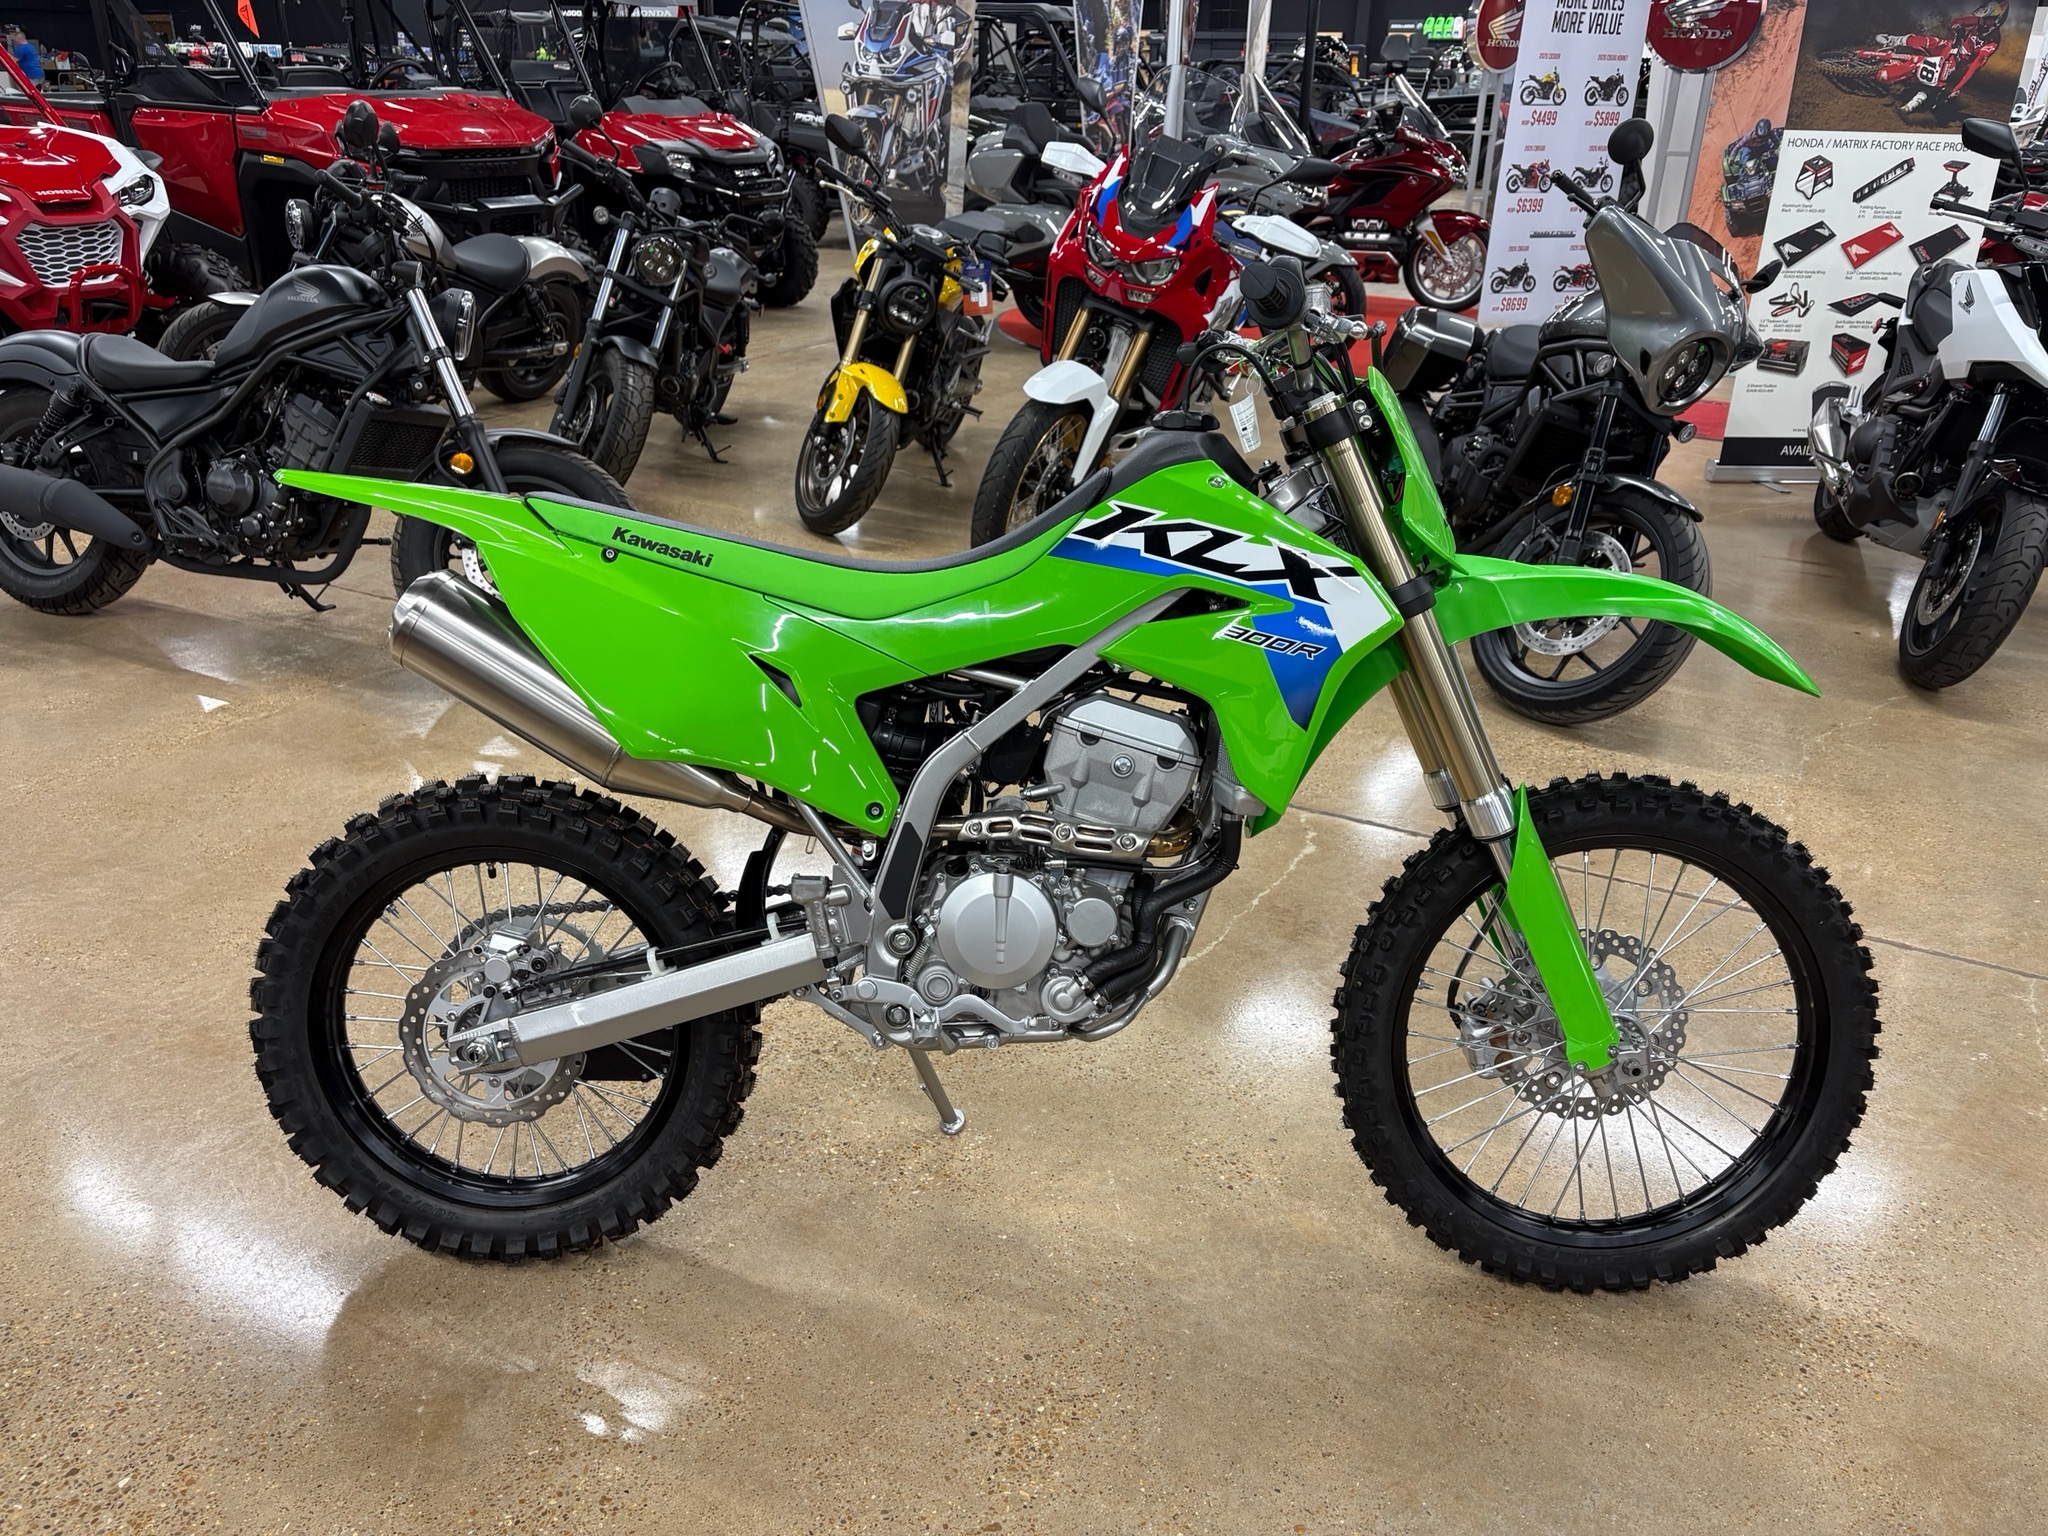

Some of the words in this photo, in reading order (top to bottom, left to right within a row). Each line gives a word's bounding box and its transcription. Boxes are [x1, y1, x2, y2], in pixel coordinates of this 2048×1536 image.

[1551, 10, 1587, 34] MORE
[1588, 11, 1625, 35] VALUE
[1662, 27, 1733, 40] HONDA
[1486, 38, 1520, 48] HONDA
[1919, 58, 1937, 83] 18
[1530, 109, 1558, 127] $4499
[1594, 109, 1620, 127] $5899
[1787, 137, 1824, 149] HONDA
[1825, 138, 1831, 149] /
[1832, 138, 1869, 149] MATRIX
[1870, 139, 1915, 151] FACTORY
[1915, 141, 1942, 152] RACE
[1515, 197, 1544, 214] $6399
[286, 295, 320, 304] HONDA
[1500, 296, 1529, 313] $8699
[611, 526, 715, 568] Kawasaki
[1069, 500, 1363, 605] KLX
[1220, 622, 1327, 660] 300R
